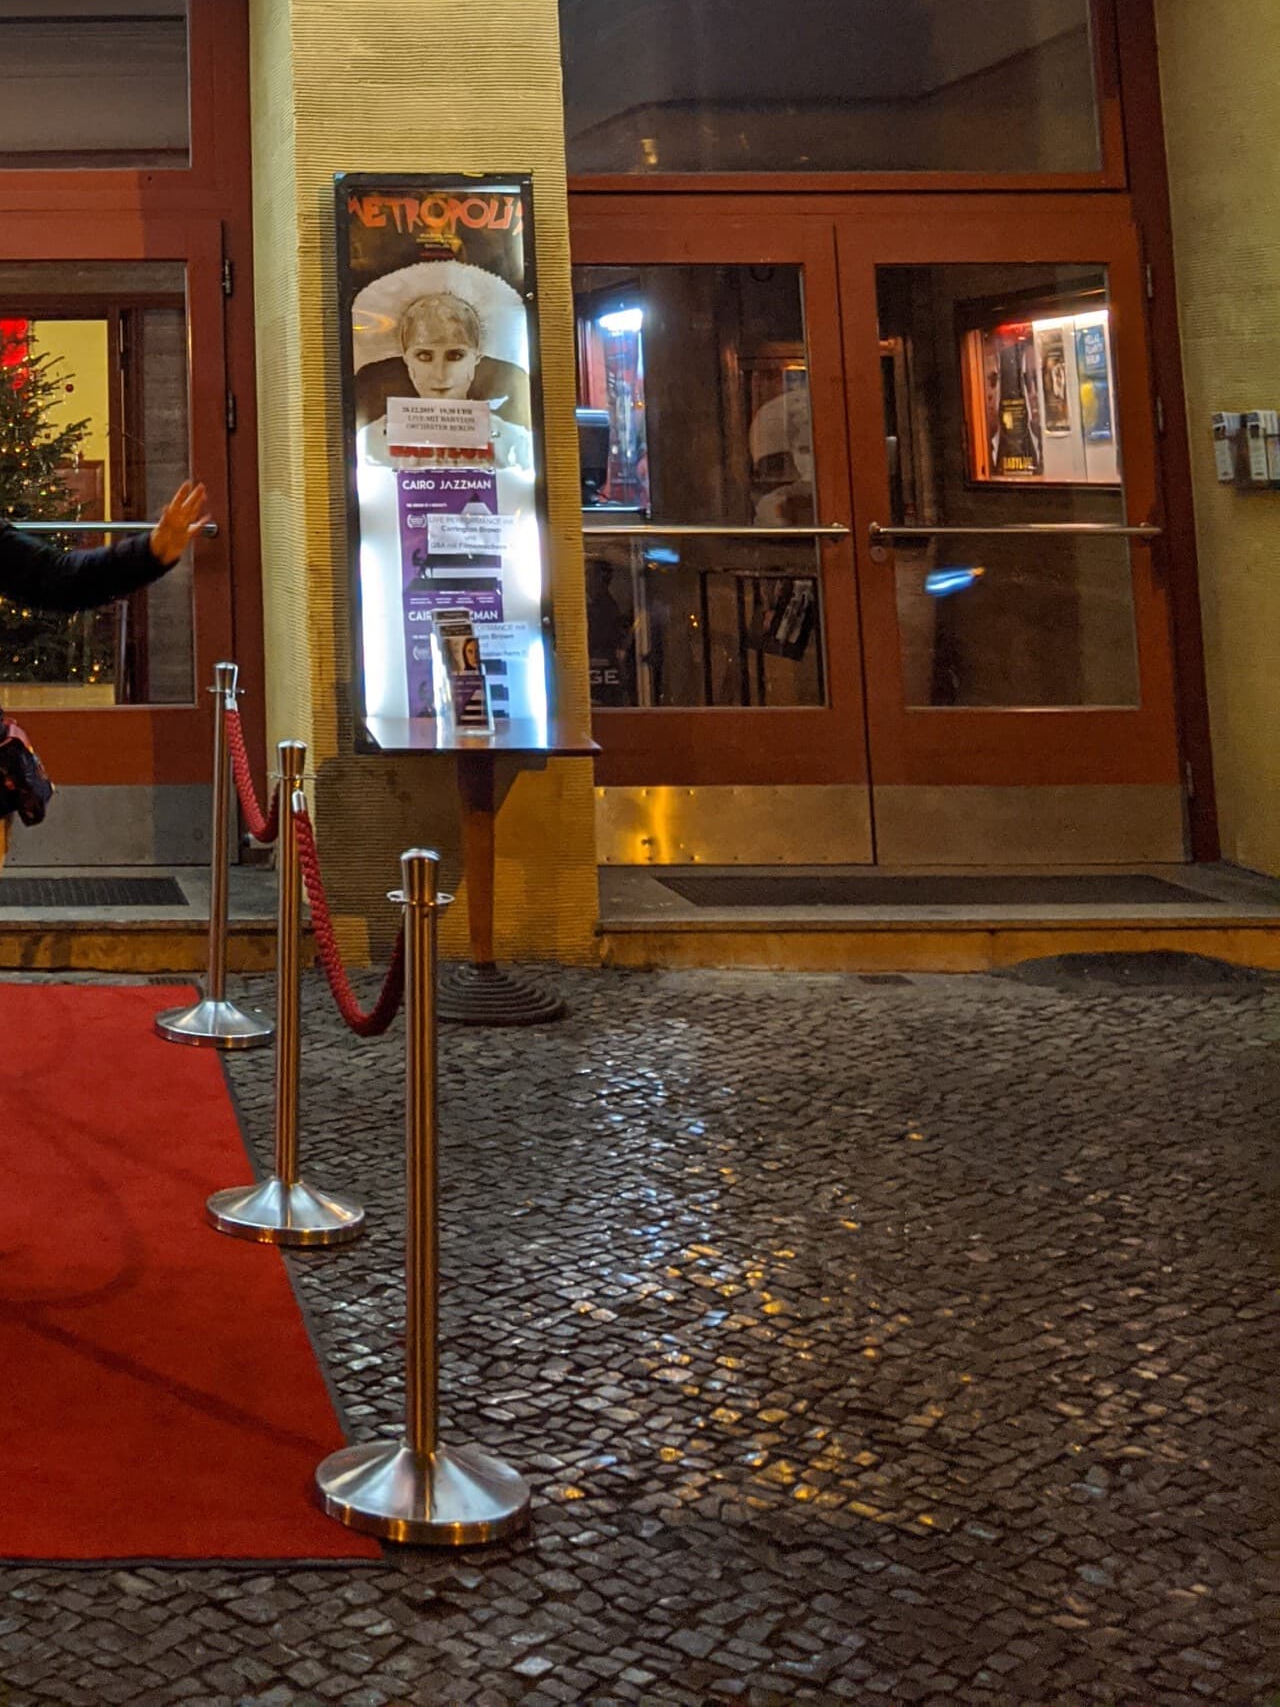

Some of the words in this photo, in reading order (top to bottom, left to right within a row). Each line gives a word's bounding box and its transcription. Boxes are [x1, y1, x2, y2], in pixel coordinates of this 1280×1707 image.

[402, 479, 436, 490] CAIRO
[439, 479, 492, 490] JAZZMAN
[408, 610, 432, 621] CAIR
